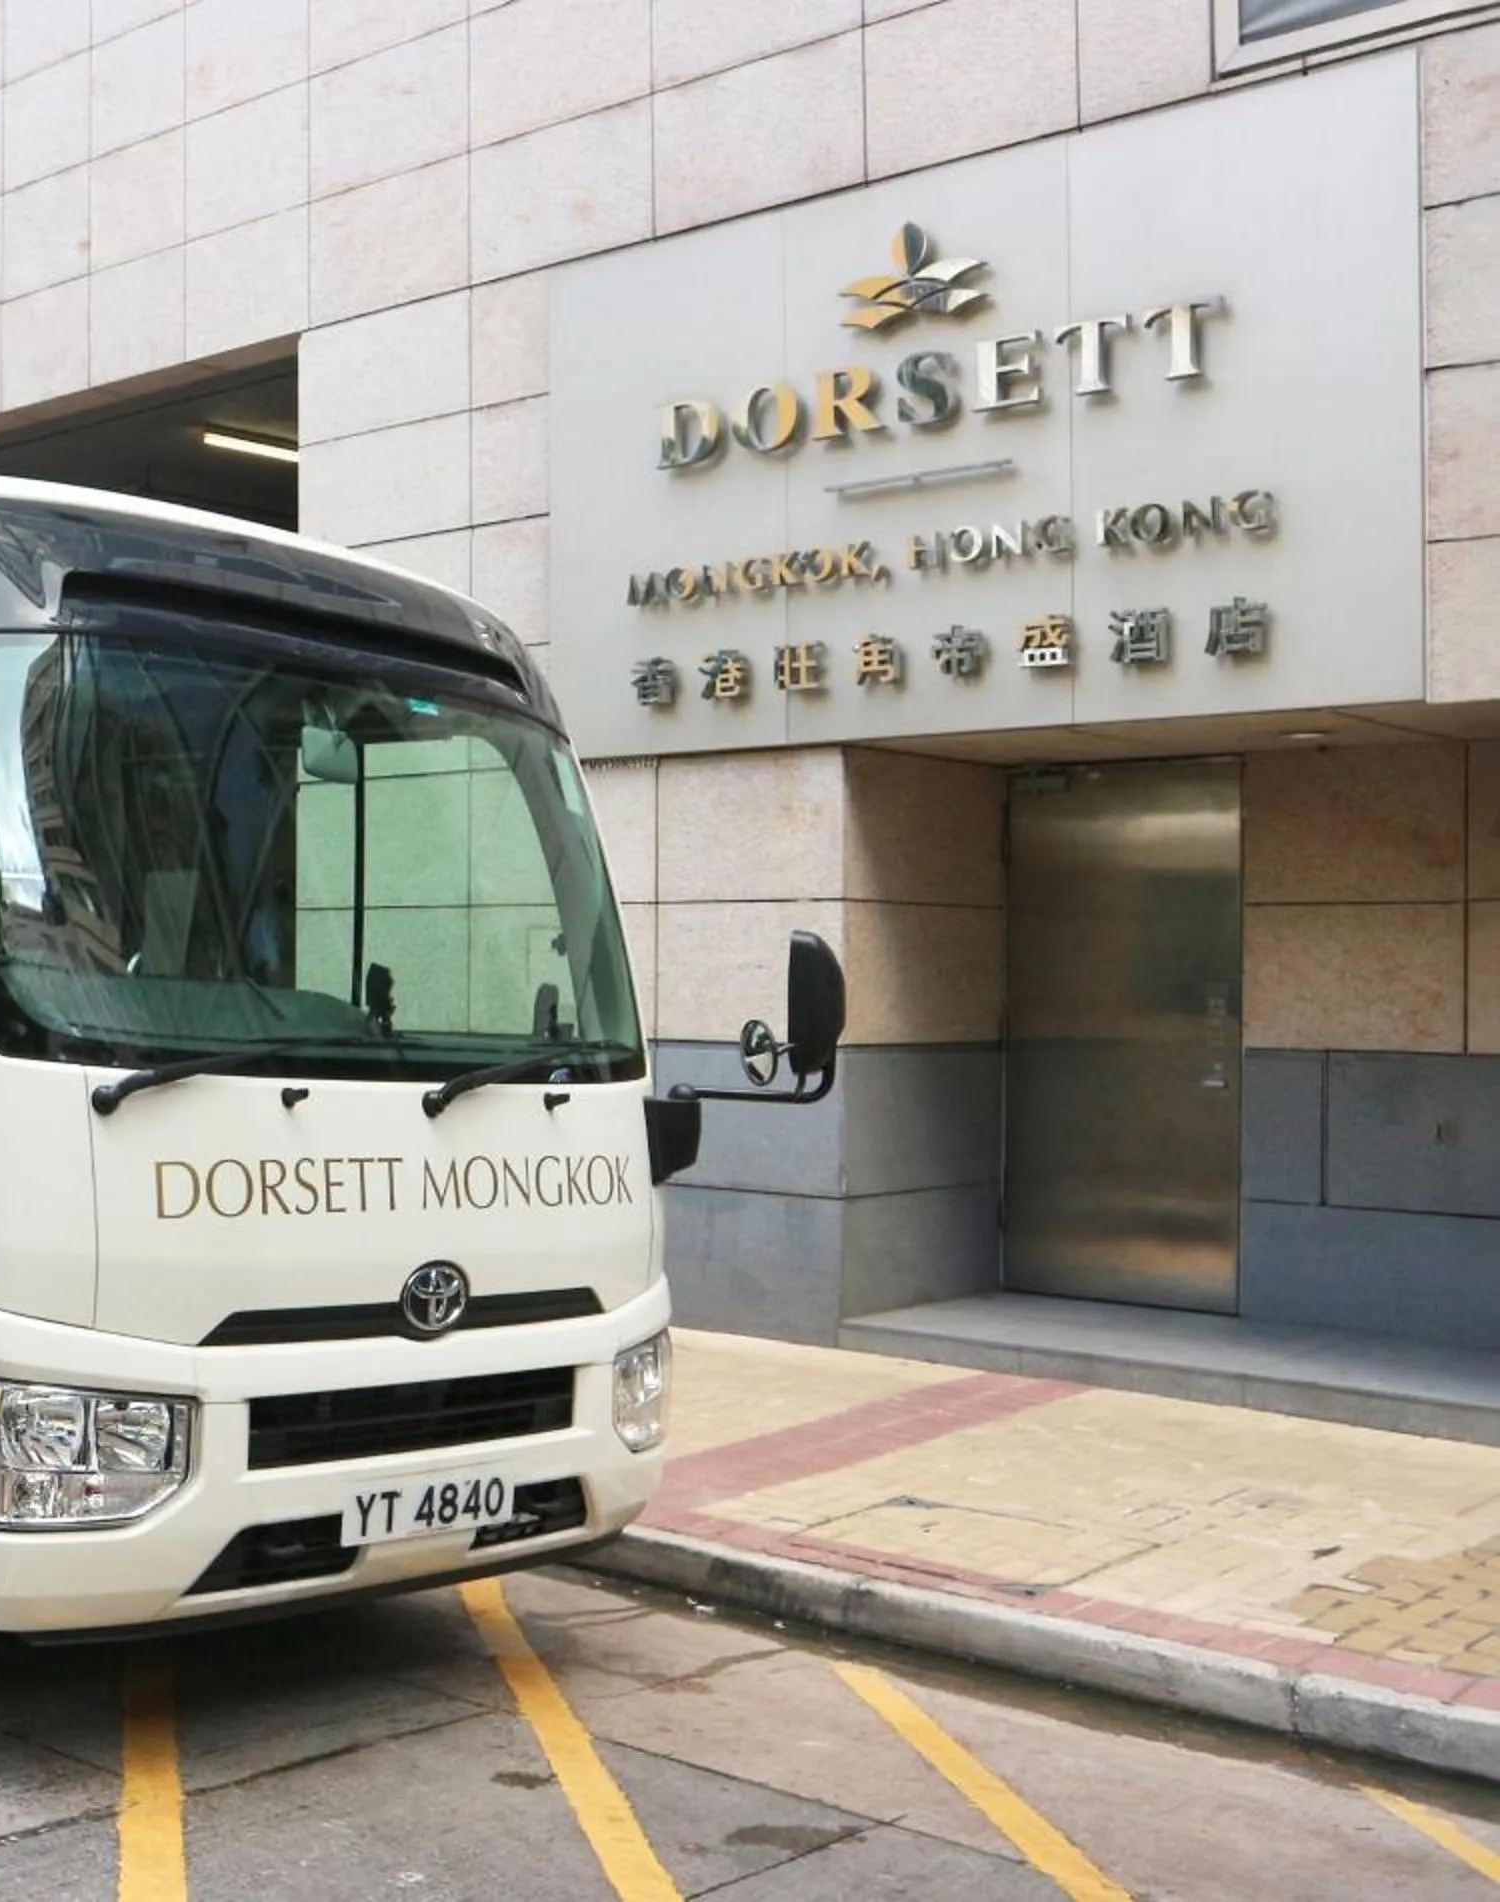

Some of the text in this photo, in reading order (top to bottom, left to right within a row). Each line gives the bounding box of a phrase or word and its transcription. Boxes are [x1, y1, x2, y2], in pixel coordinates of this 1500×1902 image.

[655, 296, 1224, 470] DORSETT
[626, 489, 1275, 606] MONGKOK, HONG KONG
[631, 596, 1271, 706] 香港旺角帝盛酒店
[154, 1155, 634, 1219] DORSETT MONGKOK
[355, 1476, 505, 1537] YT 4840
